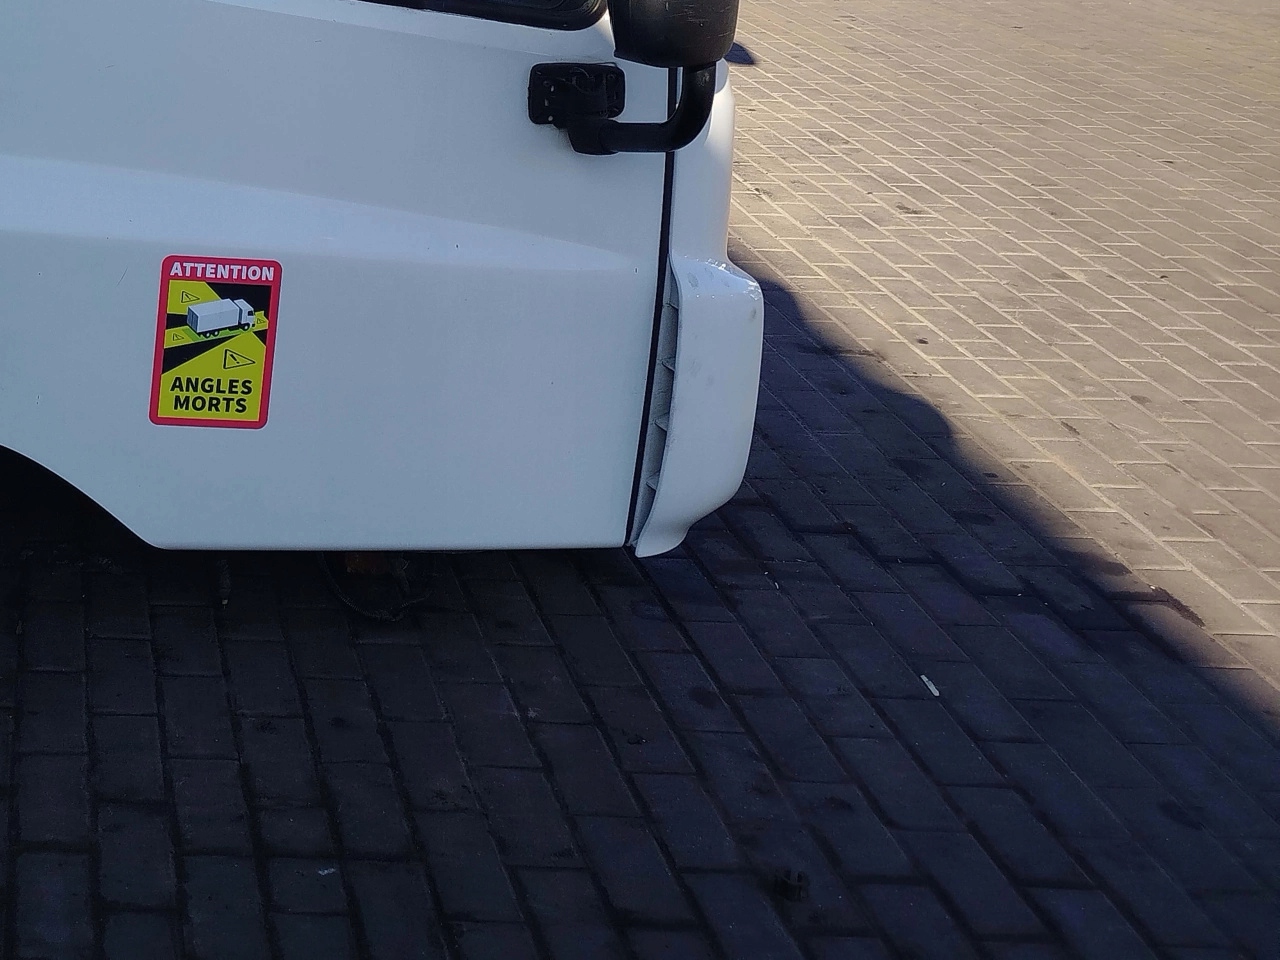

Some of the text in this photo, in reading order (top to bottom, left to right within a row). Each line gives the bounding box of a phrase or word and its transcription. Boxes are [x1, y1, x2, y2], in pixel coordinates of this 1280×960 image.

[169, 261, 274, 281] ATTENTION
[170, 376, 253, 395] ANGLES
[173, 395, 248, 413] MORTS
